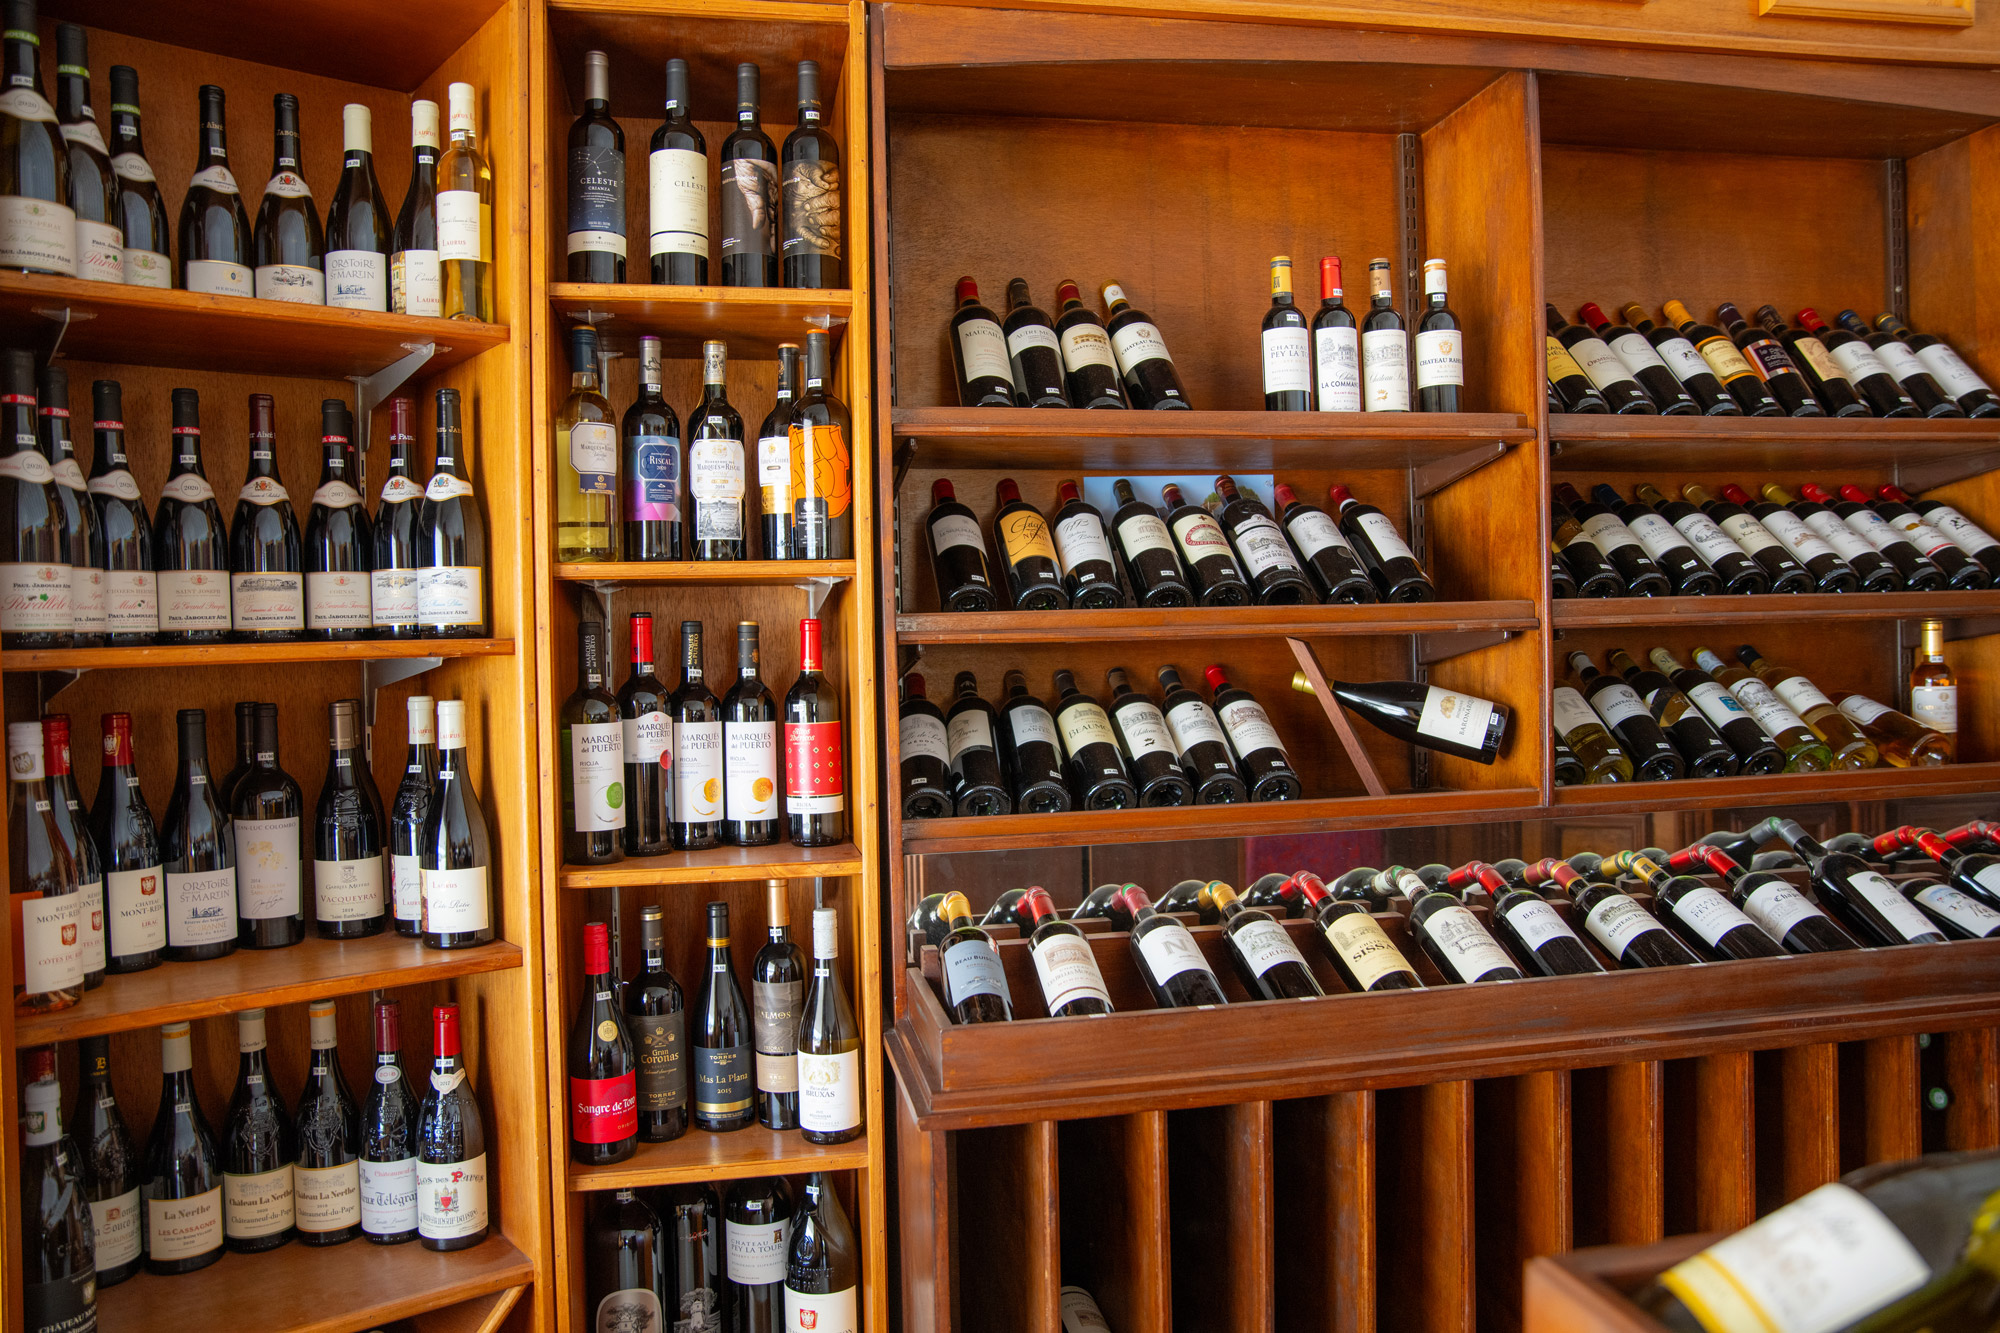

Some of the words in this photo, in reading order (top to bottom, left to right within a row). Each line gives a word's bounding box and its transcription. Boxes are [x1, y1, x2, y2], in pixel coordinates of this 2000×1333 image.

[580, 177, 618, 188] CELESTE
[1271, 350, 1286, 358] PEY
[1420, 357, 1447, 367] CHATEAU
[649, 455, 672, 466] RISCAL
[581, 733, 621, 744] MARQUÉS
[646, 730, 671, 738] PUERTO
[681, 733, 719, 742] MARQUÉS
[731, 732, 771, 741] MARQUÉS
[591, 742, 621, 753] PUERTO
[690, 740, 719, 750] PUERTO
[740, 741, 772, 749] PUERTO
[320, 892, 377, 903] VACQUEYRAS
[955, 956, 973, 967] BEAU
[641, 1052, 679, 1064] Coronas
[652, 1049, 669, 1057] Gran
[699, 1074, 714, 1084] Mas
[716, 1075, 726, 1084] La
[728, 1073, 748, 1083] Plana
[648, 1090, 676, 1098] TORRES
[578, 1102, 610, 1116] Sangre
[613, 1101, 622, 1110] de
[319, 1191, 330, 1200] La
[331, 1186, 356, 1199] Nerthe
[259, 1195, 270, 1204] La
[164, 1211, 176, 1220] La
[178, 1204, 212, 1220] Nerthe
[158, 1227, 170, 1236] LES
[172, 1218, 217, 1235] CASSAGNES
[731, 1239, 769, 1247] CHATEAU
[746, 1246, 757, 1254] LA
[758, 1243, 783, 1253] TOUR
